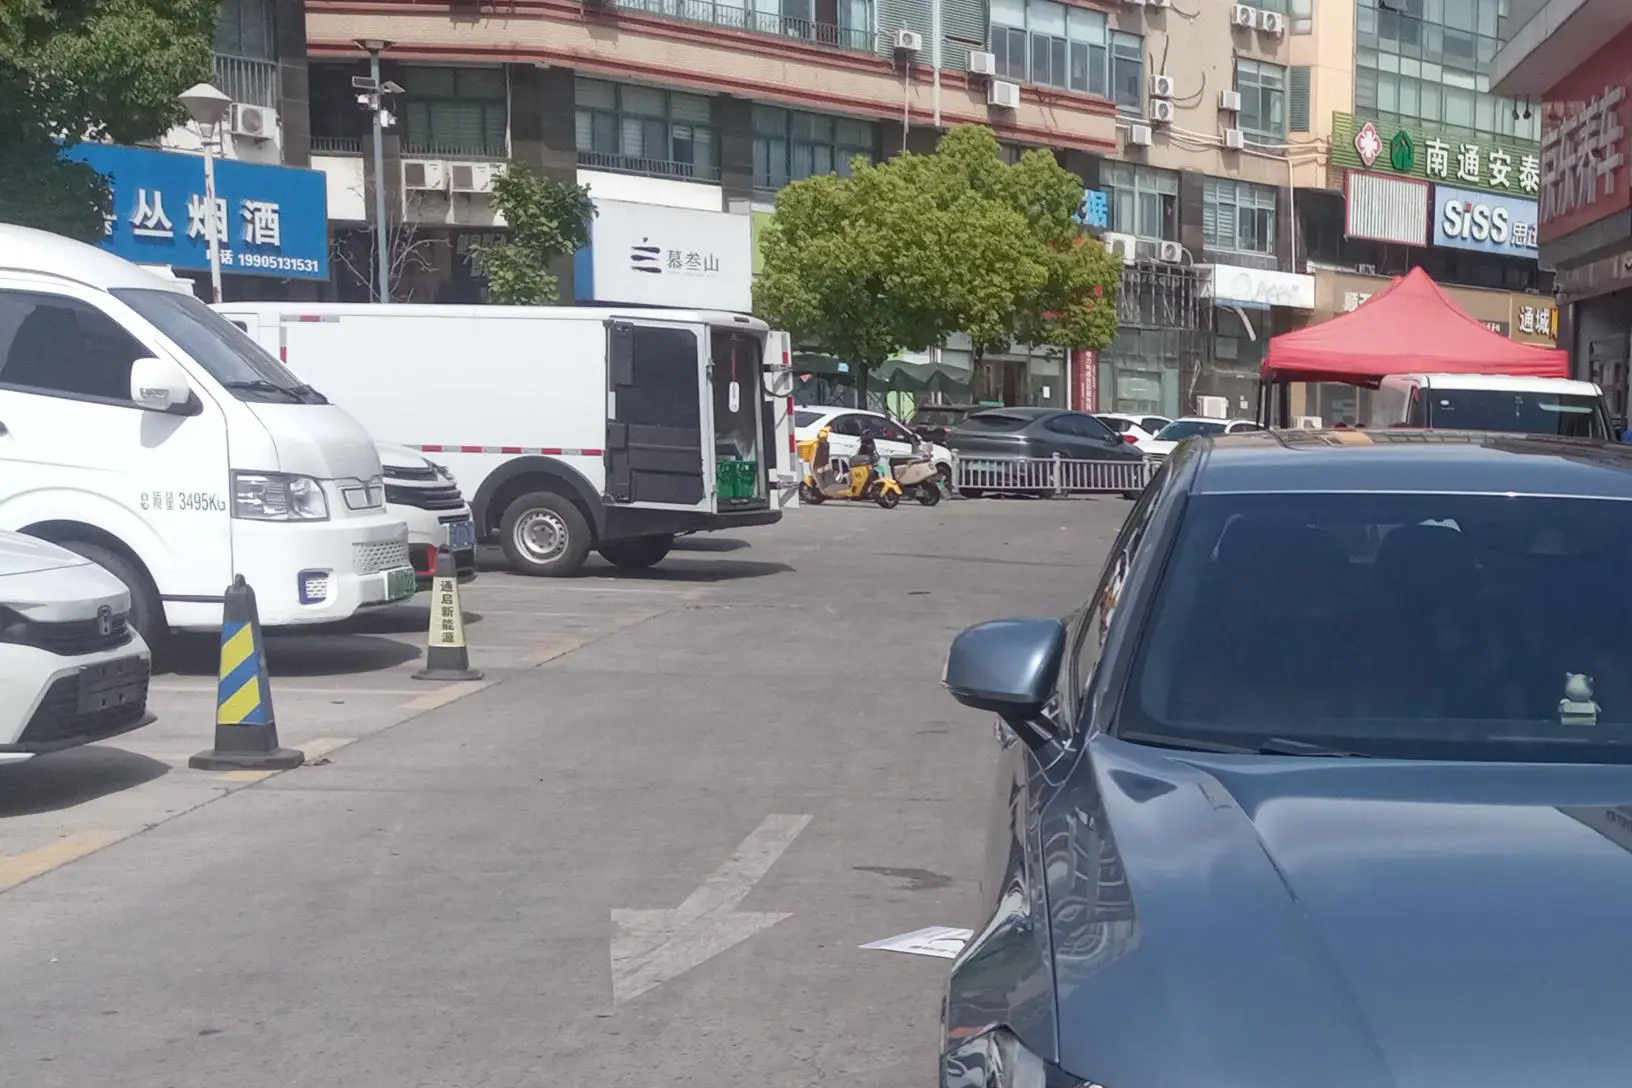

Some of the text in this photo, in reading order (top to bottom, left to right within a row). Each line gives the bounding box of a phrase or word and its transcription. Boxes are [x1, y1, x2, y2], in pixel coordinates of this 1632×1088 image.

[1424, 137, 1540, 192] 南通安泰
[238, 253, 319, 273] 19905131531
[178, 492, 226, 511] 3495KG
